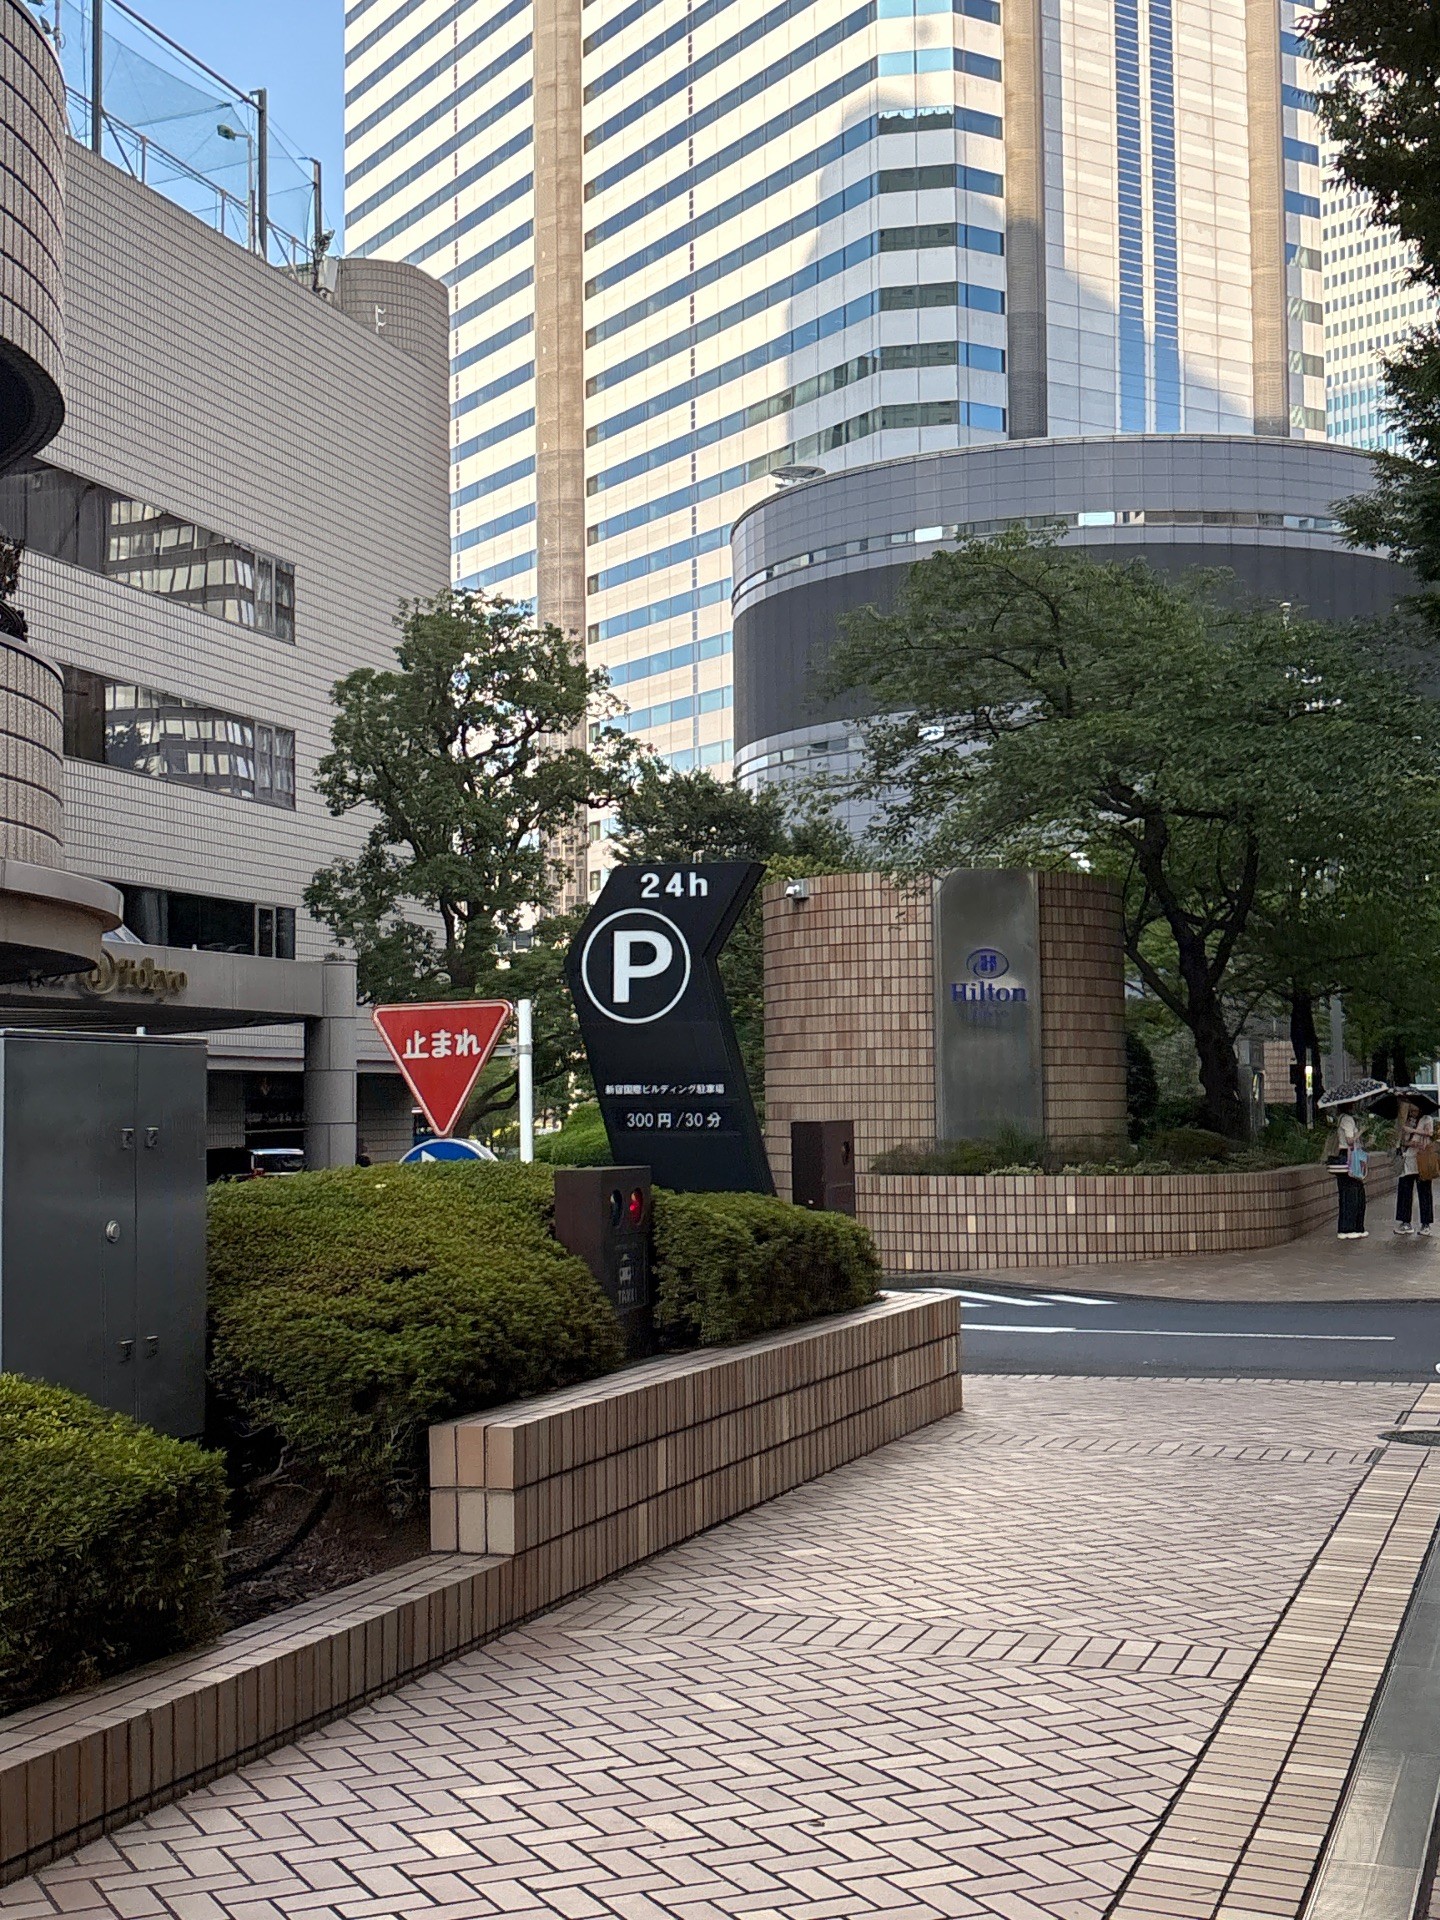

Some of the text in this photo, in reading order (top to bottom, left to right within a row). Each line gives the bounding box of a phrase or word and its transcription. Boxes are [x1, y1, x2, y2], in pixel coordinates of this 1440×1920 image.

[640, 871, 709, 899] 24h
[613, 930, 673, 1003] P
[950, 981, 1028, 1002] Hilton
[402, 1028, 481, 1059] 止まれ
